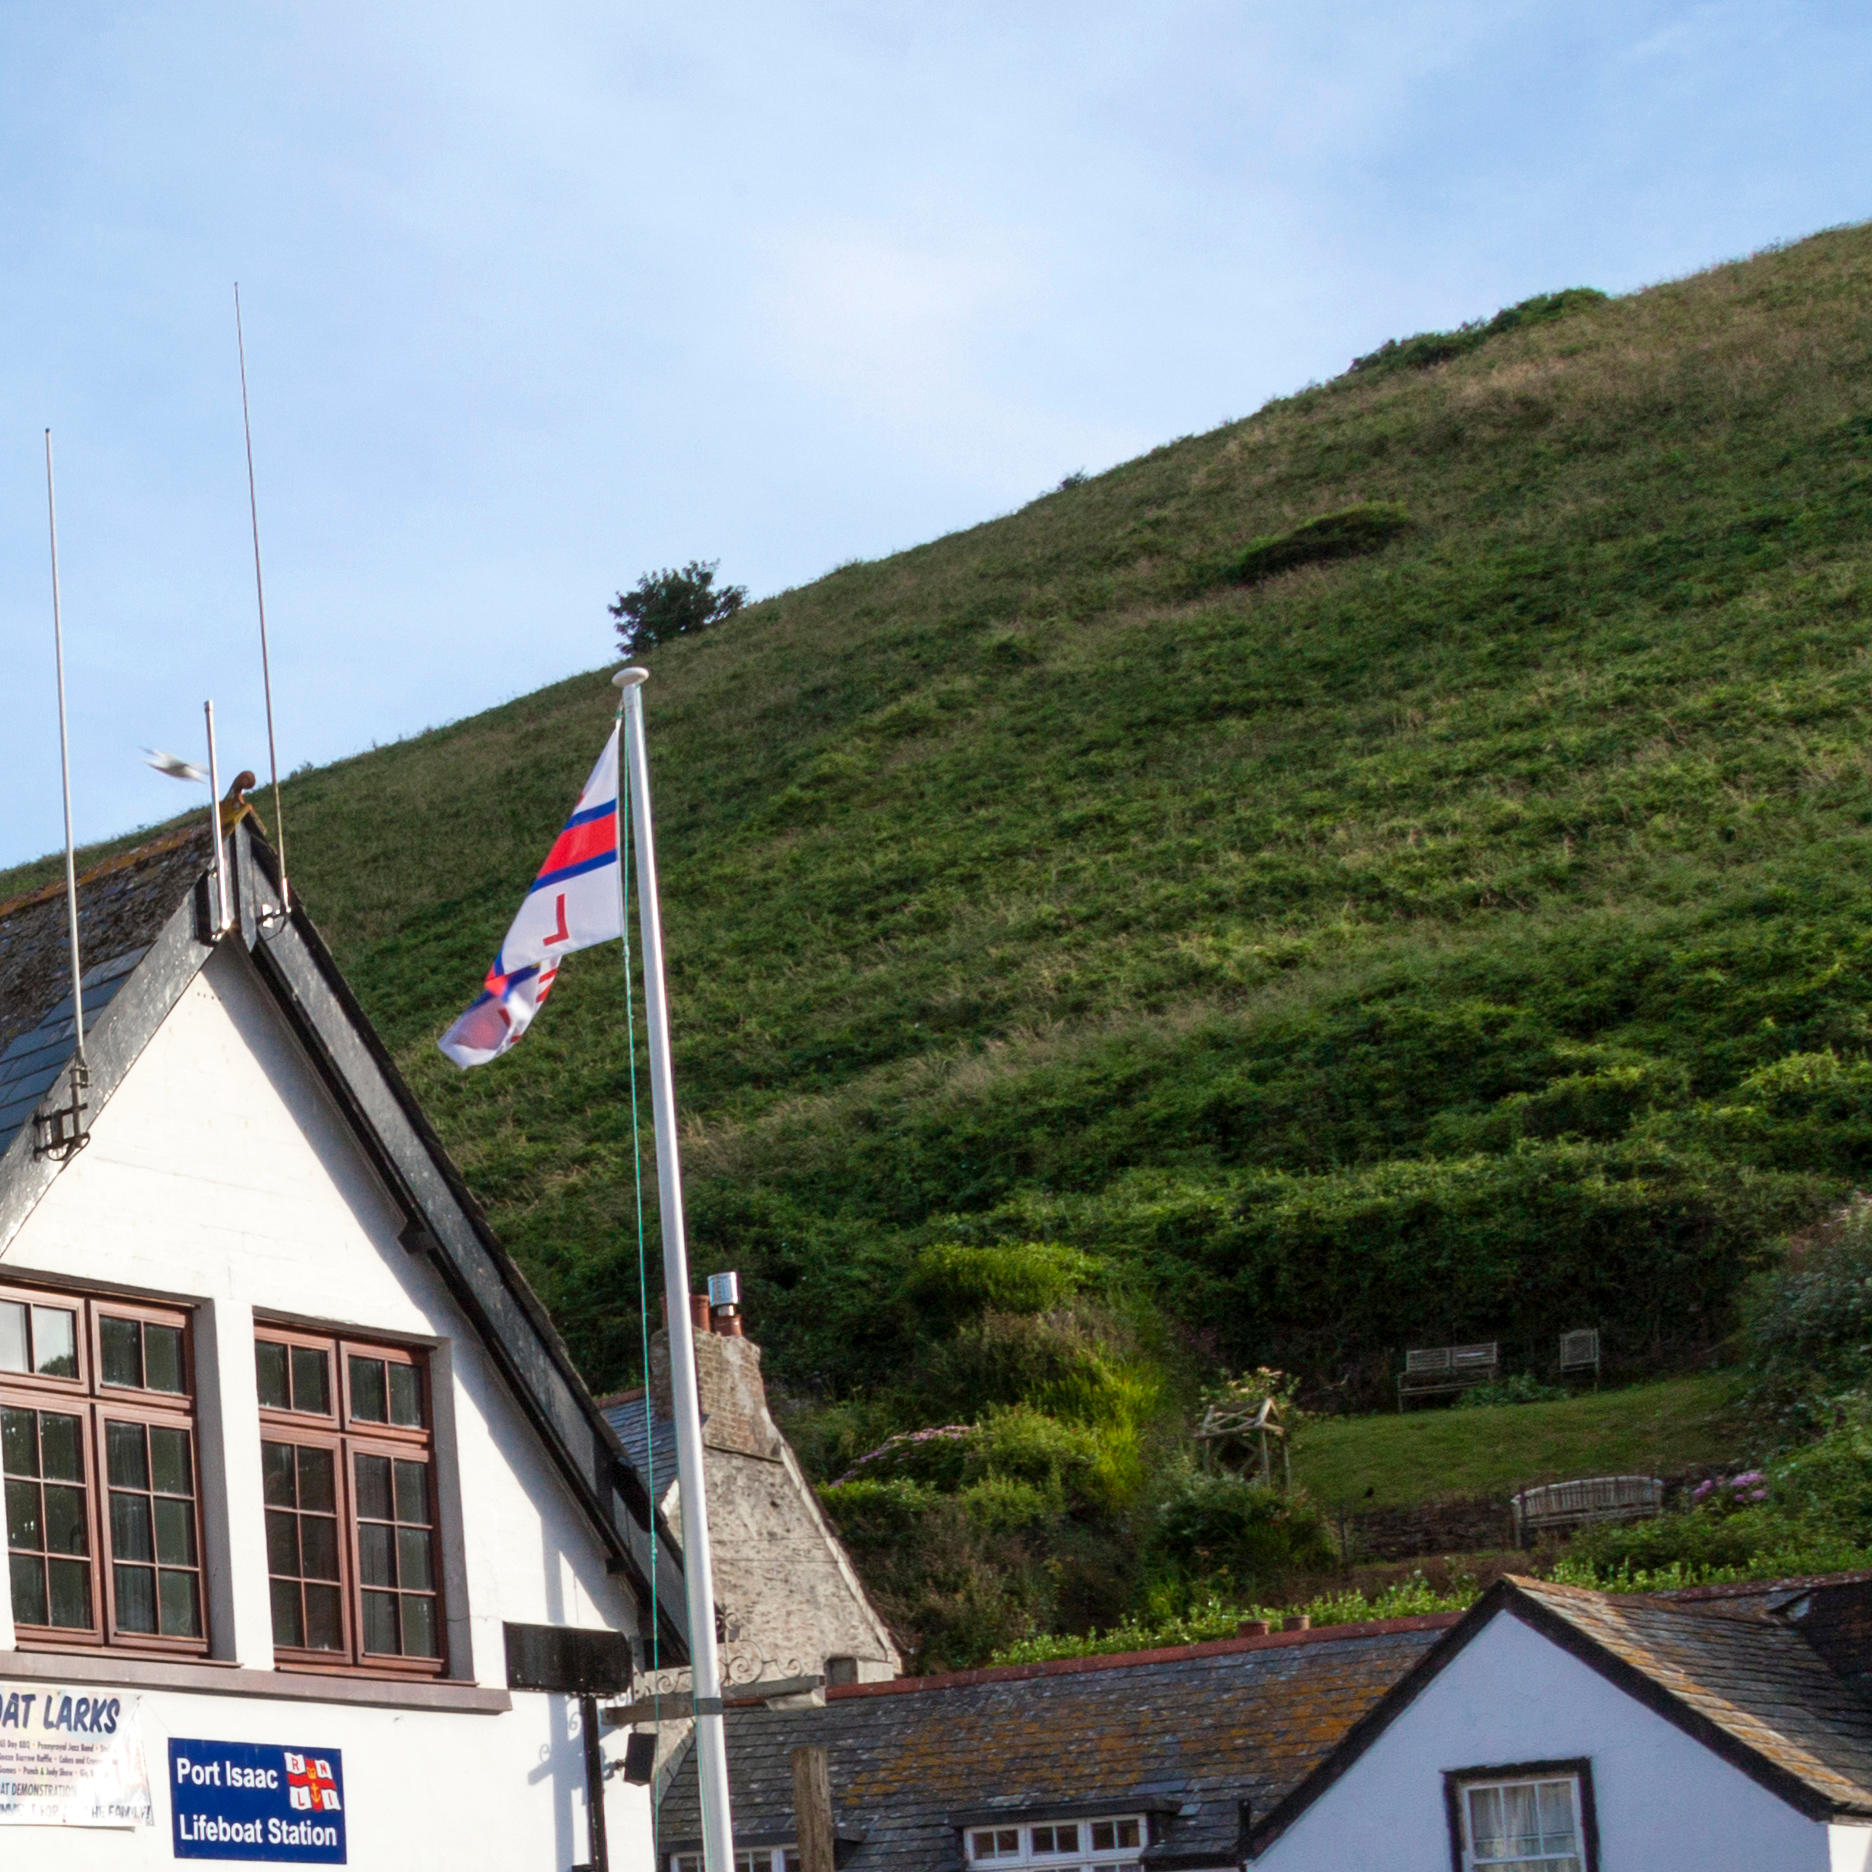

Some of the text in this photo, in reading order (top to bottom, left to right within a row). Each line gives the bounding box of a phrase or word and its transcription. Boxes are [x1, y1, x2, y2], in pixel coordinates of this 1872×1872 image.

[43, 1694, 121, 1734] LARKS
[176, 1758, 278, 1789] Port Isaac
[179, 1814, 337, 1847] Lifeboat Station
